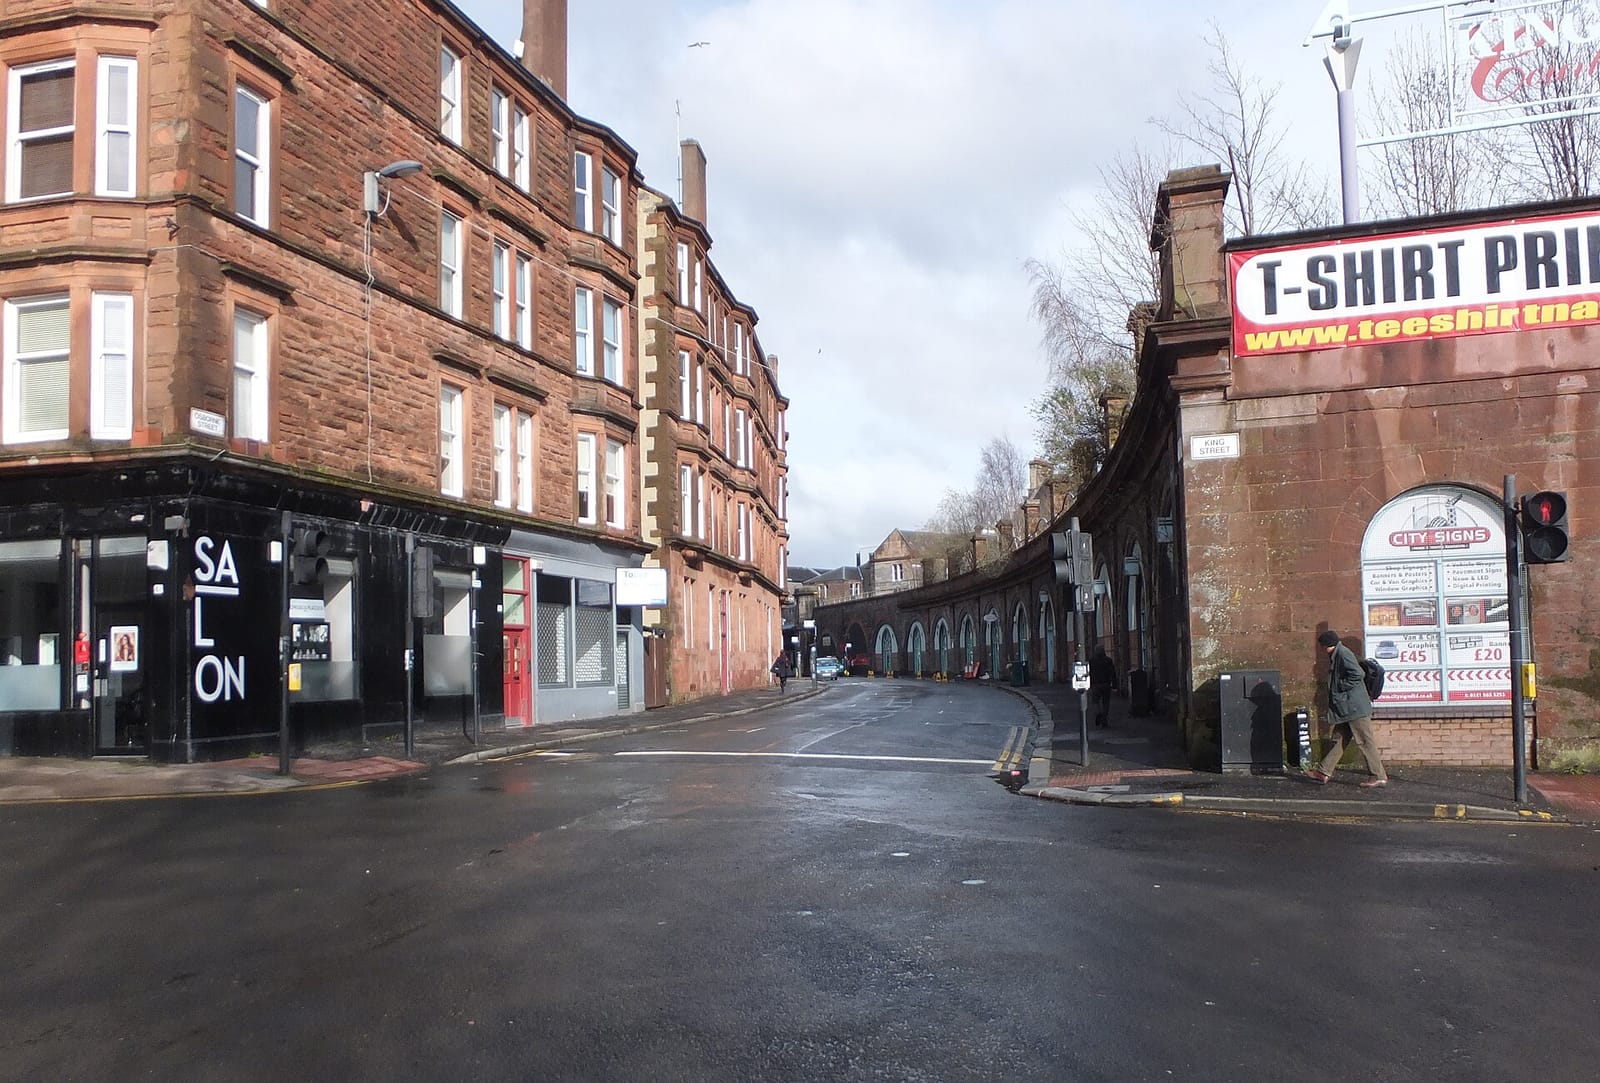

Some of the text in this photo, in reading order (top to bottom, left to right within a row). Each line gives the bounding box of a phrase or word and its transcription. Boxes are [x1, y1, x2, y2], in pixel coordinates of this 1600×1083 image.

[1256, 239, 1465, 316] T-SHIRT
[197, 420, 218, 431] STREET
[1200, 446, 1230, 455] STREET
[1393, 529, 1486, 544] CITY SIGNS
[1400, 650, 1427, 662] £45
[1474, 648, 1502, 660] £20
